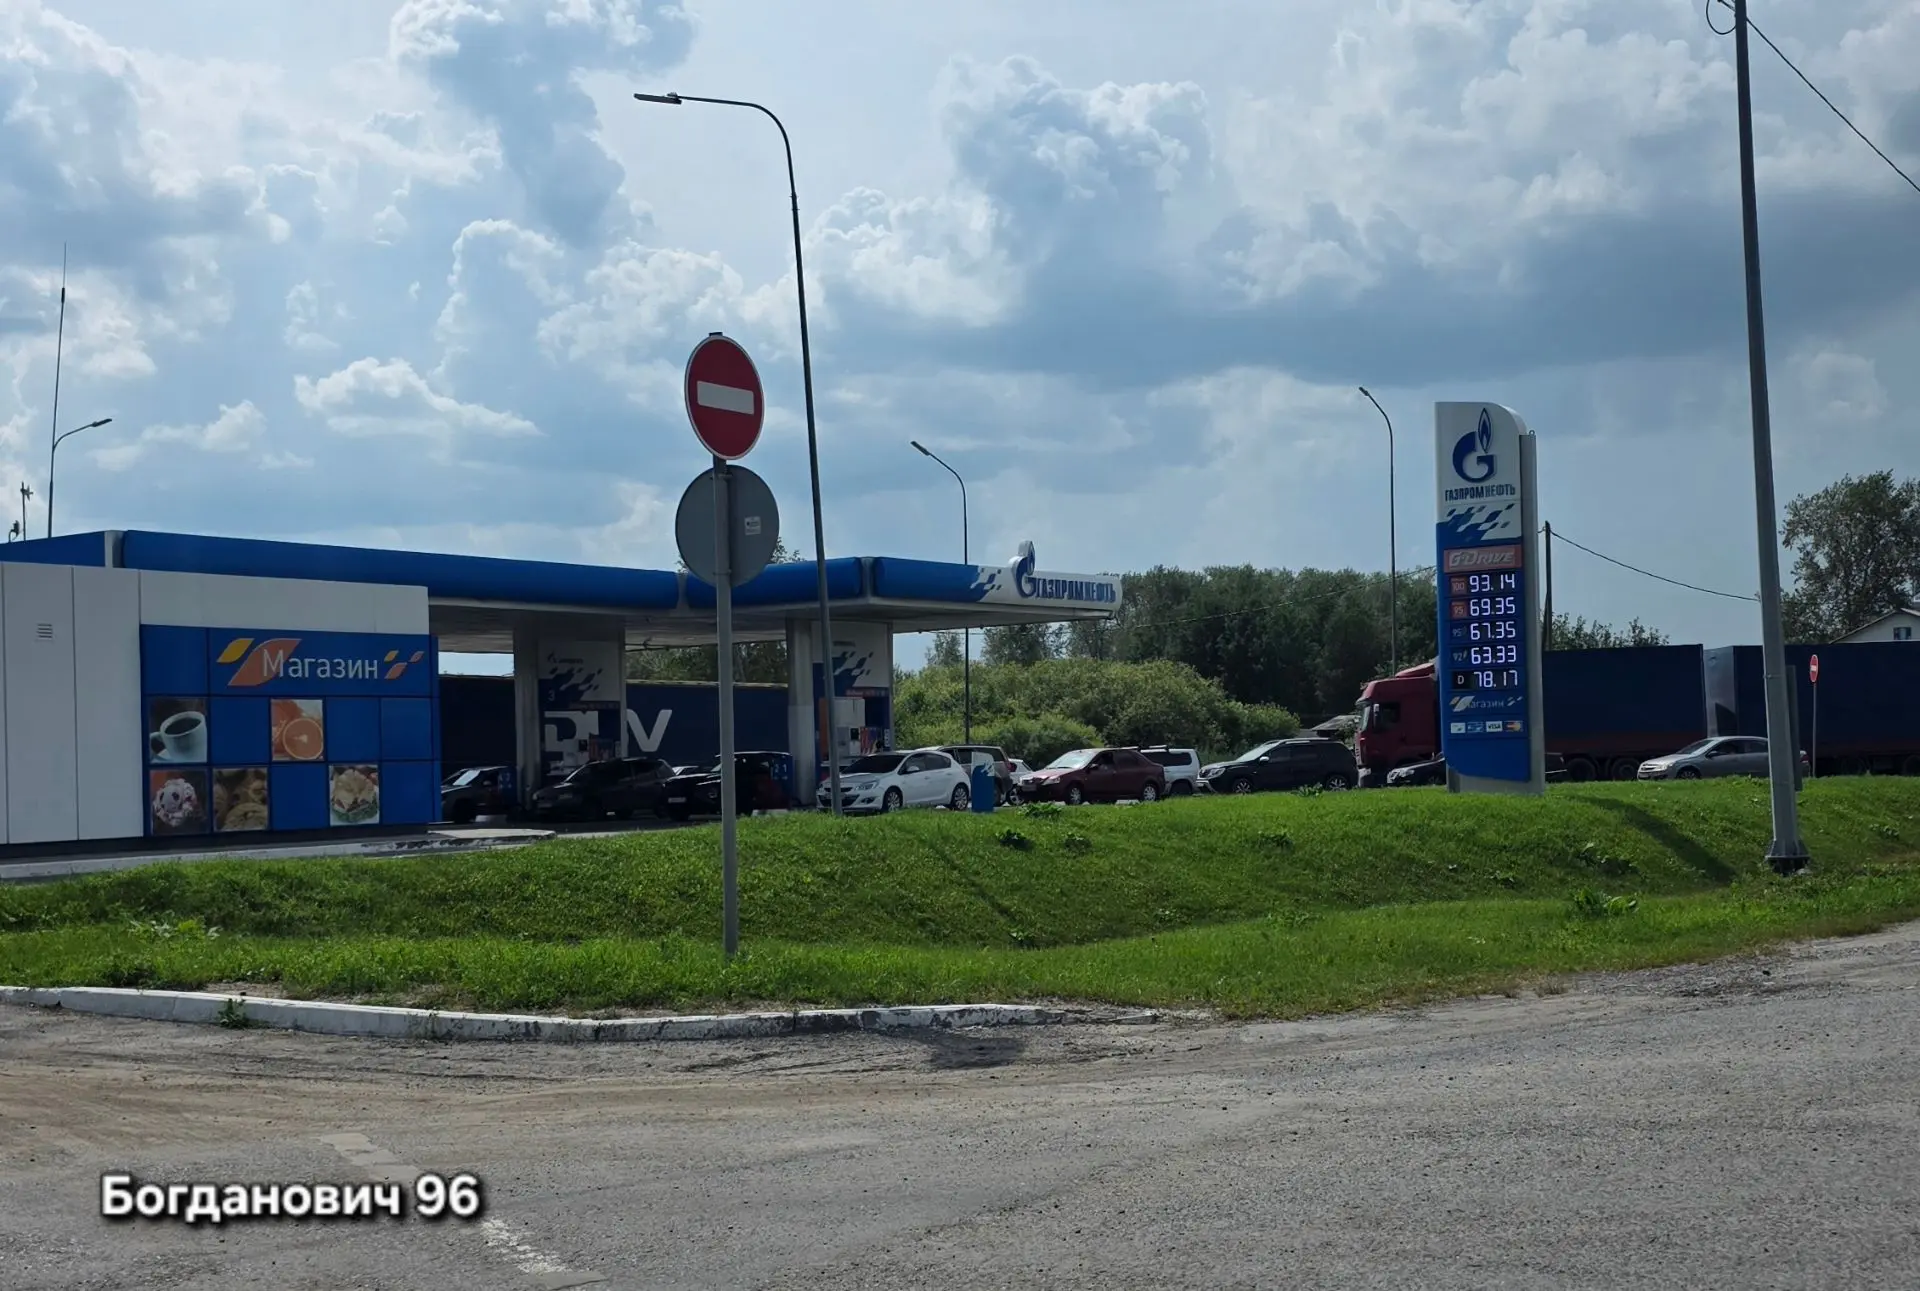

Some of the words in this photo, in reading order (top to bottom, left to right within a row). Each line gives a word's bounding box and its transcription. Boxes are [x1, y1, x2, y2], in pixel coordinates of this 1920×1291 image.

[1445, 484, 1515, 501] ГАЗПРОМНЕФТЬ
[1035, 578, 1116, 603] ГАЗПРОМНЕФТЬ
[1469, 573, 1515, 592] 93.14
[1453, 605, 1464, 615] 95
[1469, 597, 1516, 616] 69.35
[1470, 621, 1516, 640] 67.35
[262, 648, 378, 679] Магазин
[1471, 645, 1516, 664] 63.33
[1457, 675, 1465, 684] D
[1473, 670, 1518, 688] 78.17
